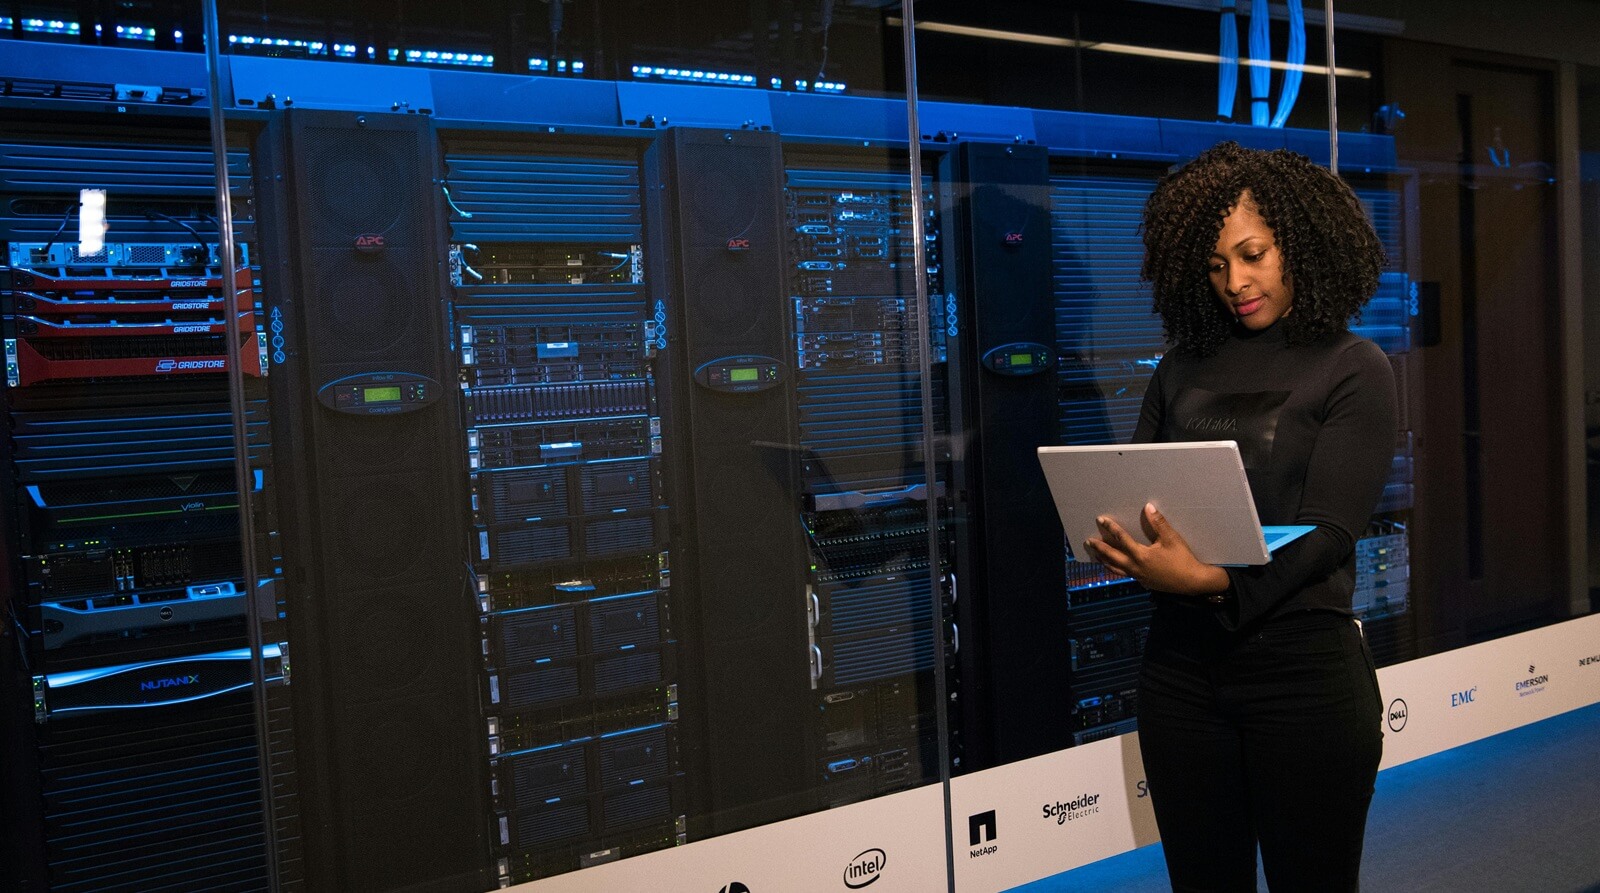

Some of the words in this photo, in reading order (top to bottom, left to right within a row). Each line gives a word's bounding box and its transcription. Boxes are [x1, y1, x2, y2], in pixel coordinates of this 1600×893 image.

[356, 236, 384, 246] APC
[1006, 233, 1023, 241] APC
[728, 239, 750, 247] APC
[172, 302, 210, 310] GRIDSTORE
[173, 325, 211, 333] GRIDSTORE
[178, 360, 225, 369] GRIDSTORE
[181, 501, 205, 512] Violin
[141, 674, 199, 691] NUTANIX
[1515, 674, 1549, 691] EMERSON
[1390, 710, 1406, 721] DELL
[1042, 793, 1100, 819] Schneider
[1067, 805, 1100, 822] Electric
[969, 845, 998, 859] NetApp
[849, 856, 880, 879] intel
